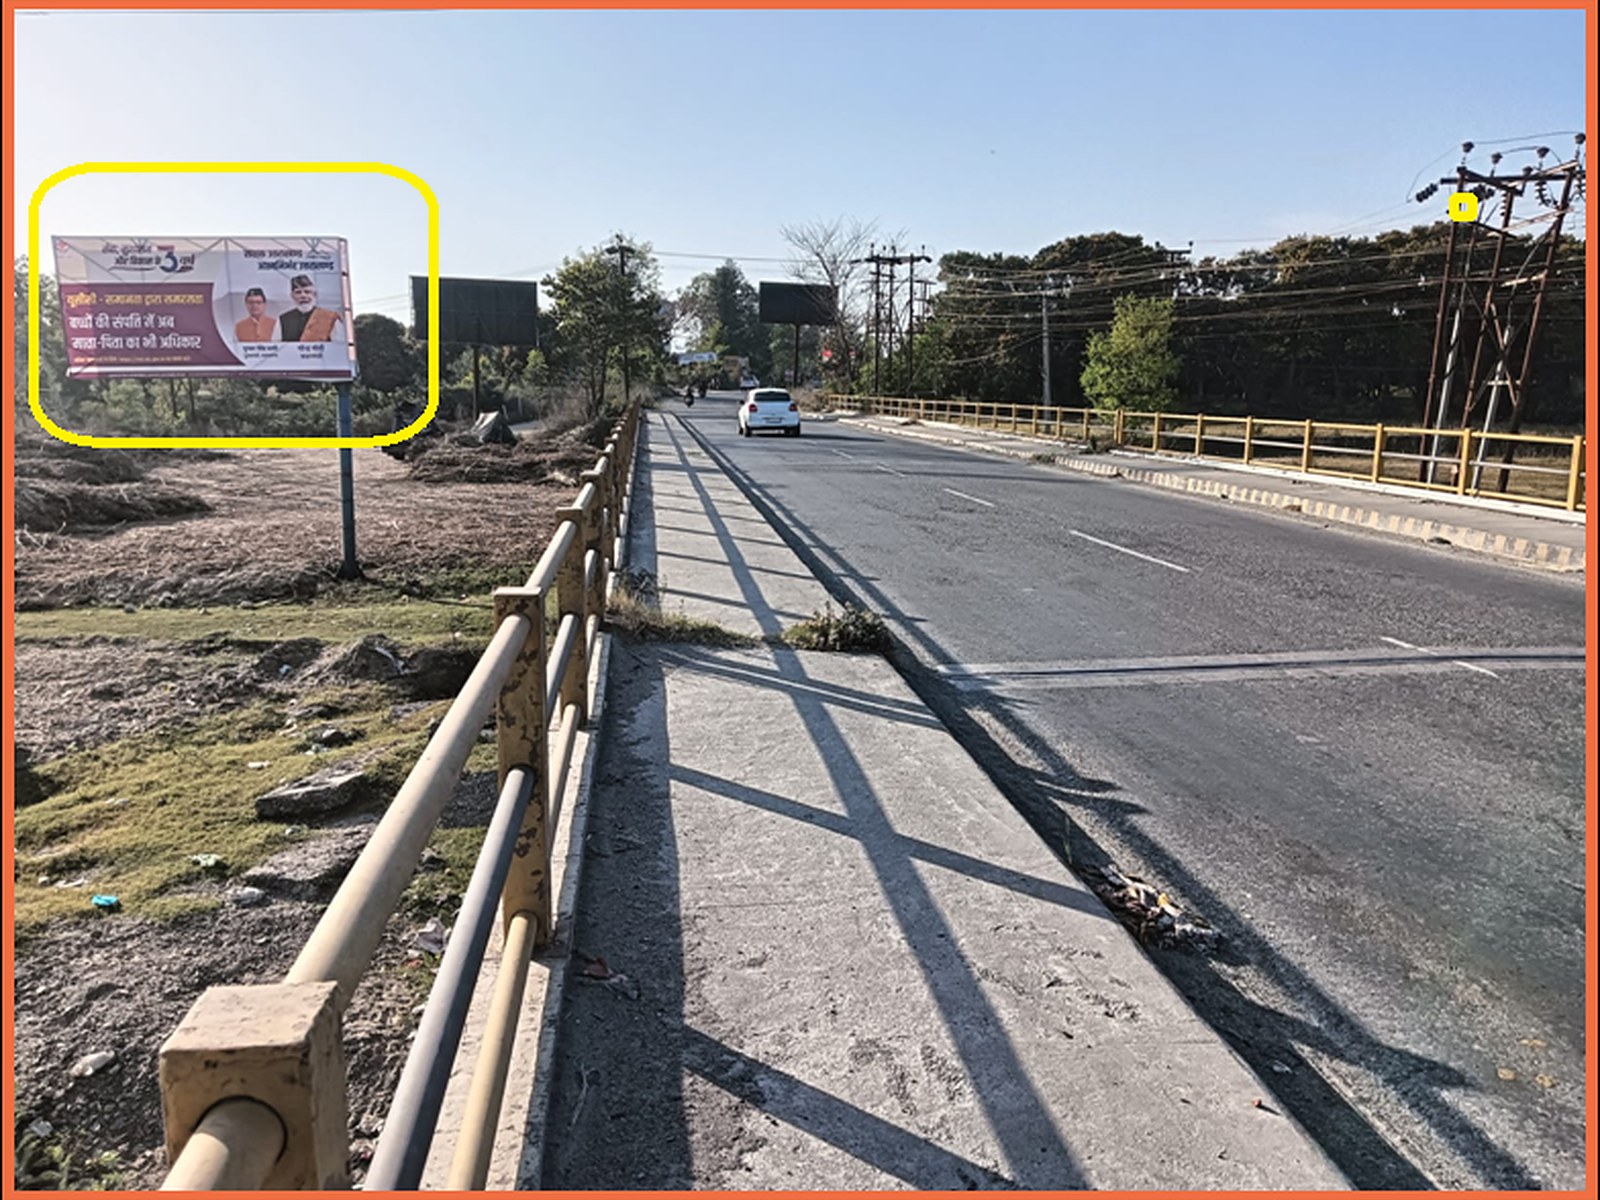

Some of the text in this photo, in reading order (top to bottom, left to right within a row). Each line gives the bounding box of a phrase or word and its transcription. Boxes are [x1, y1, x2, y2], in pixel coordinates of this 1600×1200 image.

[94, 312, 110, 328] की
[125, 336, 140, 349] का
[141, 333, 157, 349] भी
